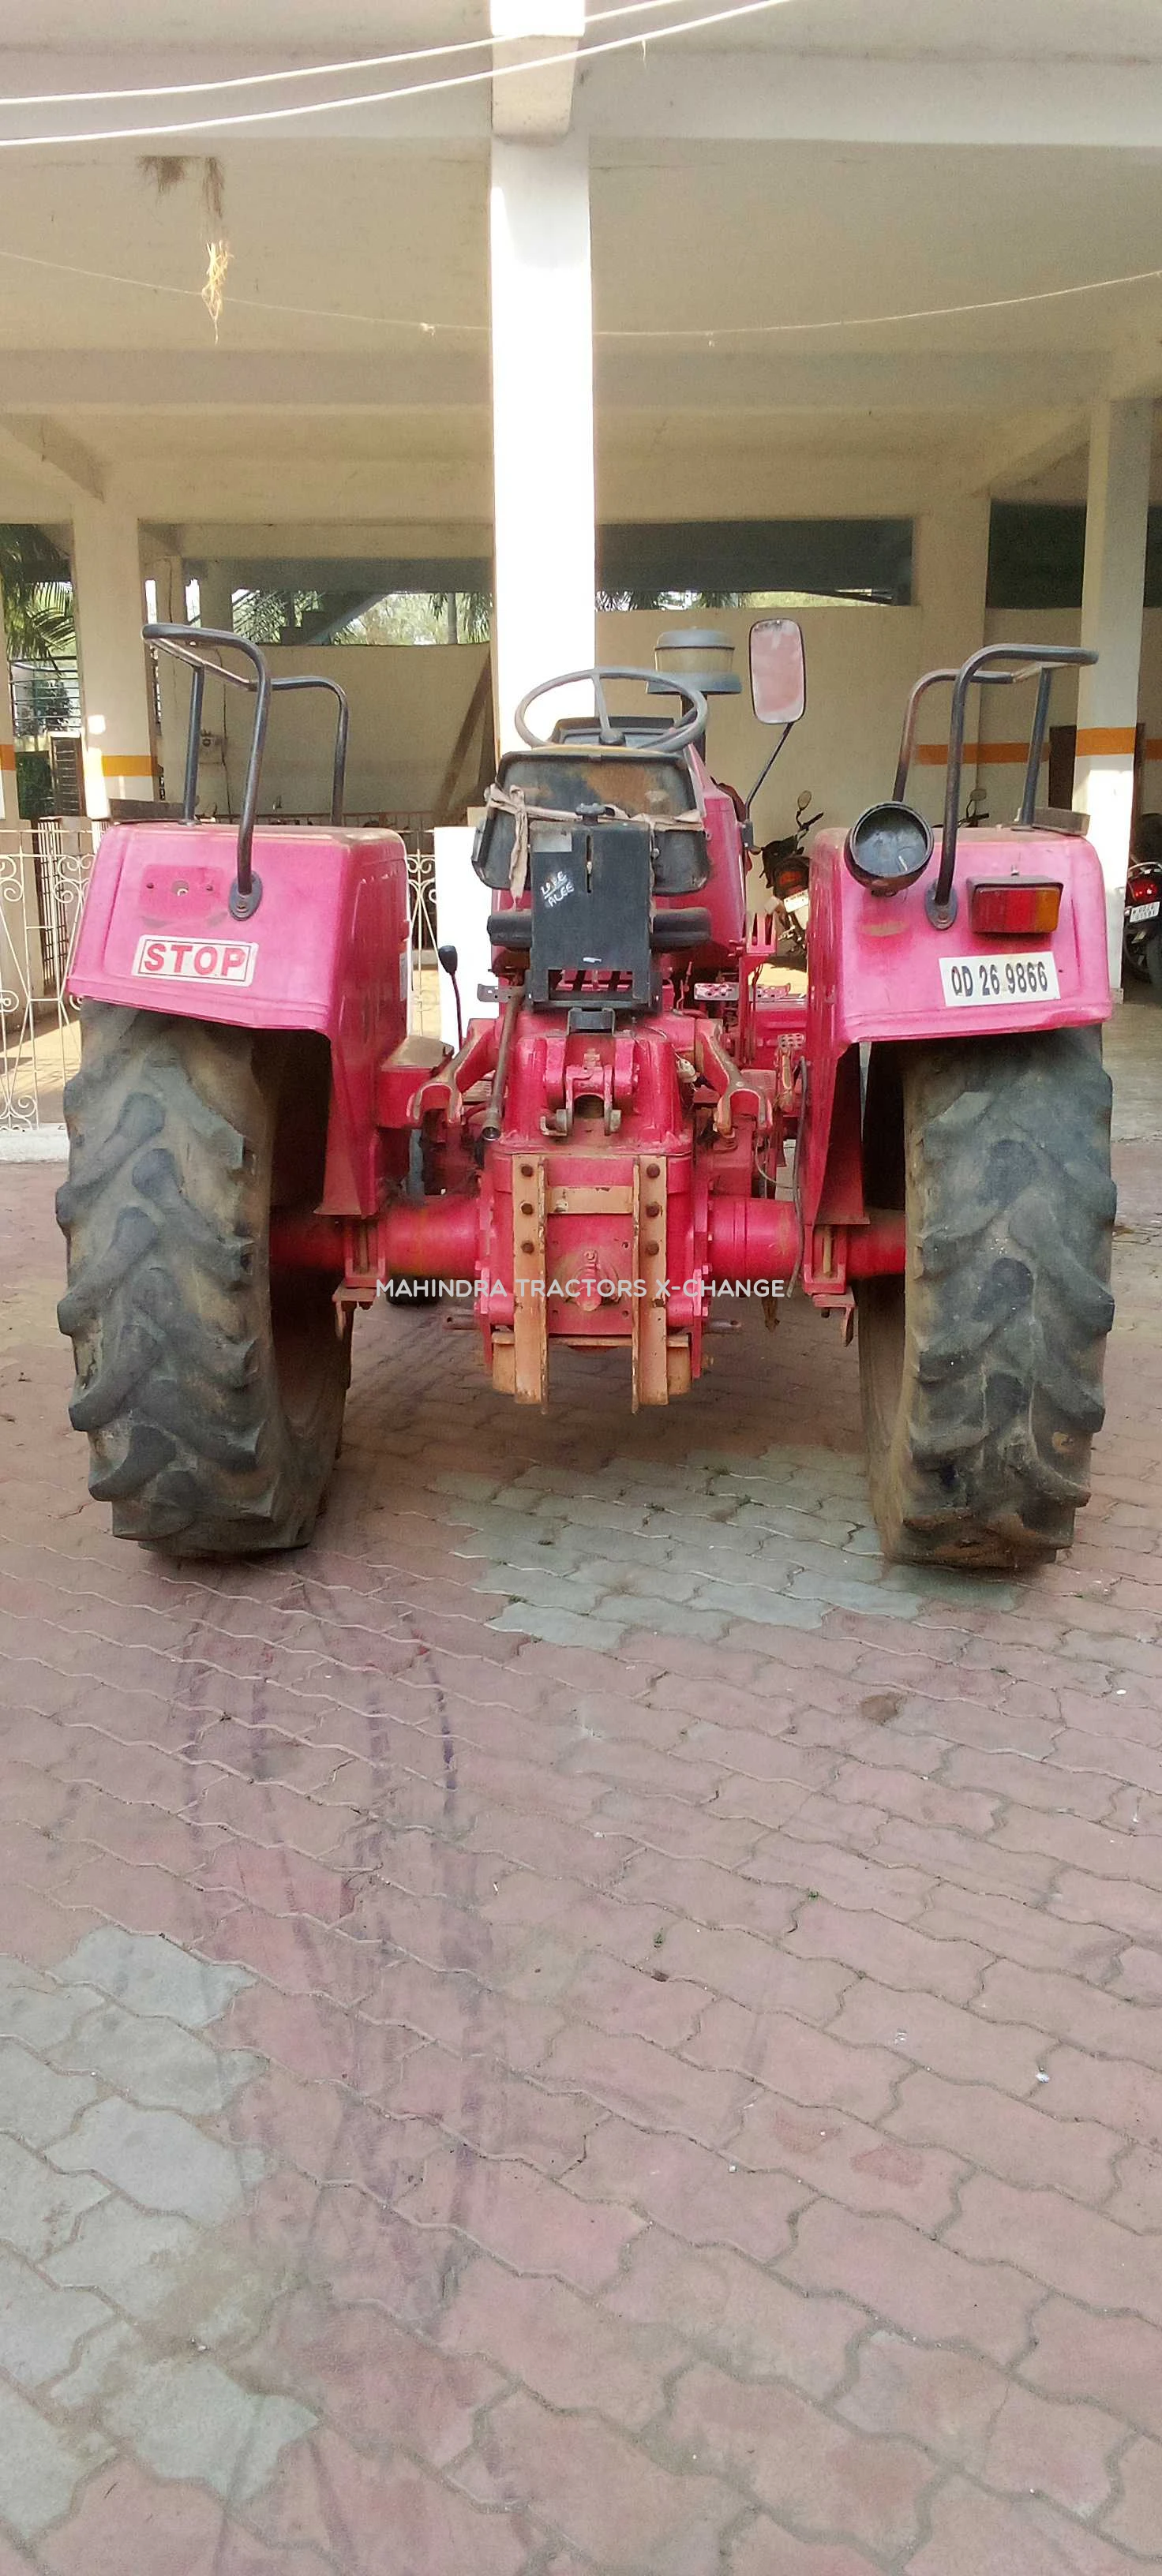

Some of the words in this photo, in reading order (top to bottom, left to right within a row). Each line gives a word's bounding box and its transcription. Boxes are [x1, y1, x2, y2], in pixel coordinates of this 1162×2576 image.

[144, 943, 246, 976] STOP
[950, 965, 973, 997] OD
[979, 964, 1000, 996] 26
[1005, 960, 1048, 994] 9866
